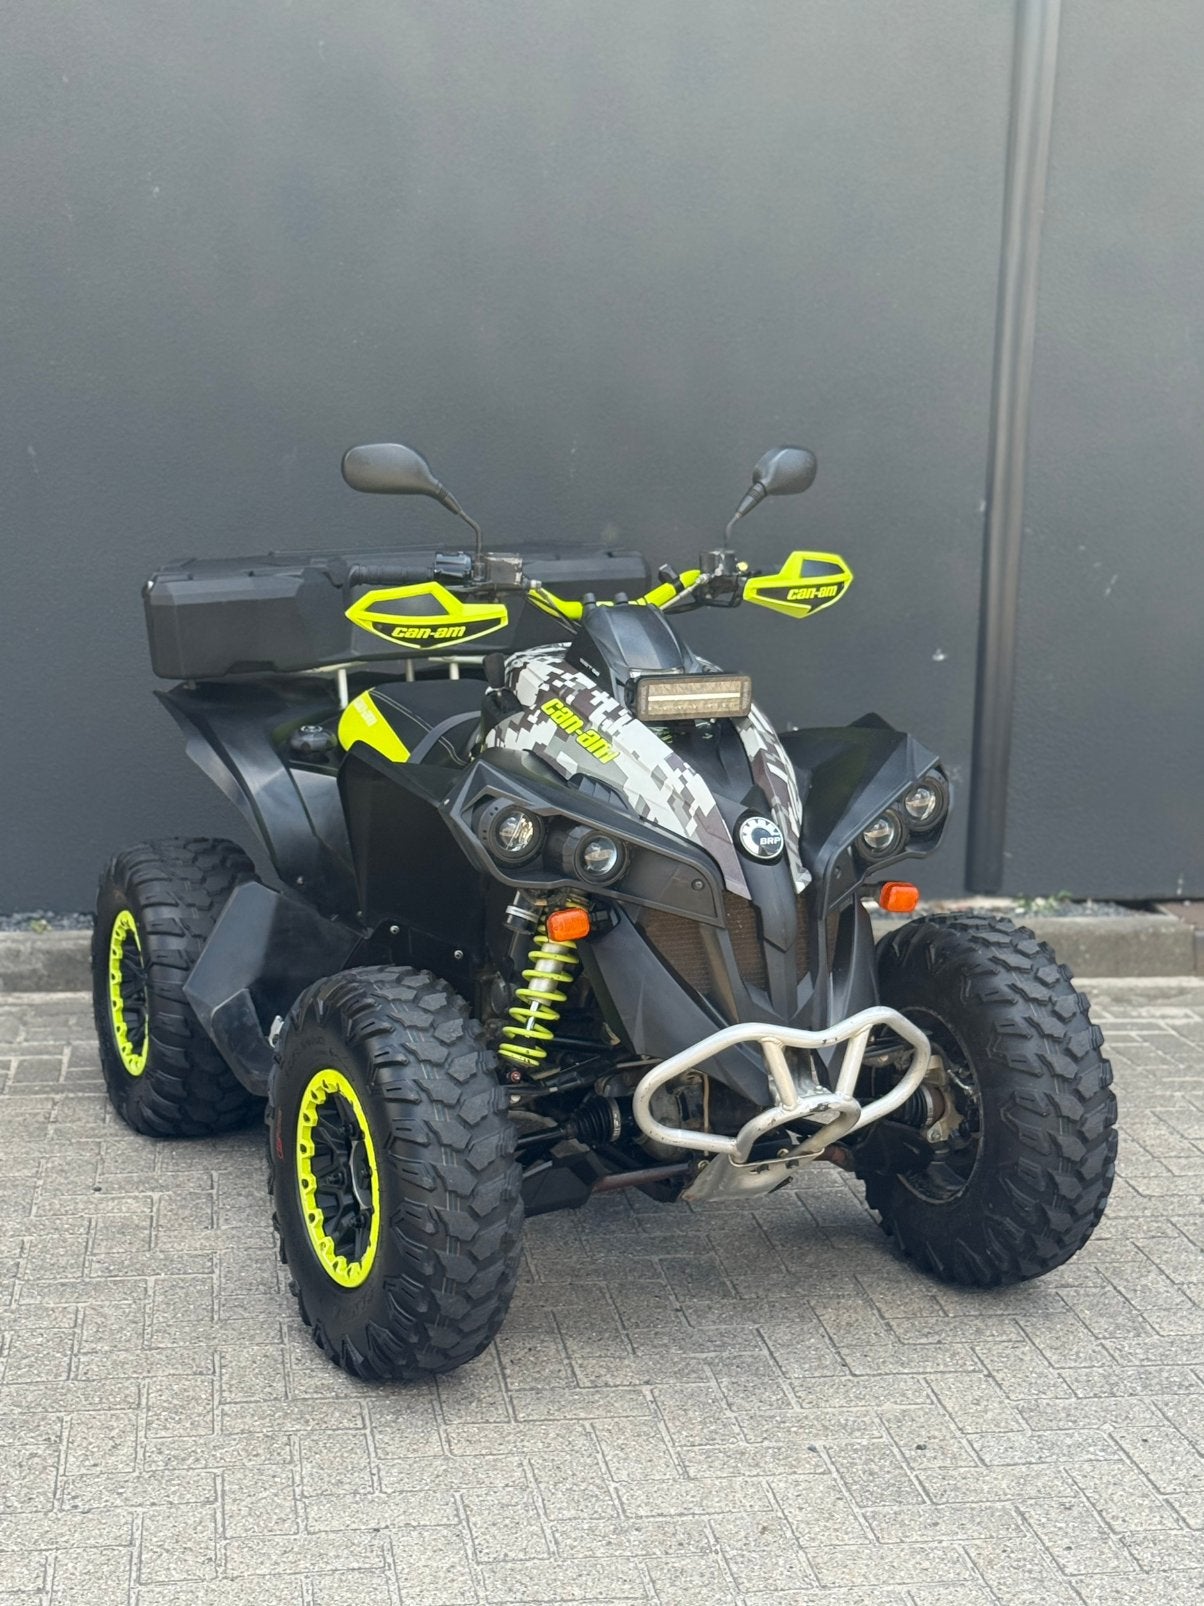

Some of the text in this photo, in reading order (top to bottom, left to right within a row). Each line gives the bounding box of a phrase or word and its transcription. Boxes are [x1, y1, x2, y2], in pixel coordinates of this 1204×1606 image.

[787, 585, 838, 600] can-am
[391, 626, 466, 639] can-am
[540, 698, 620, 764] can-am
[760, 836, 781, 845] BRP
